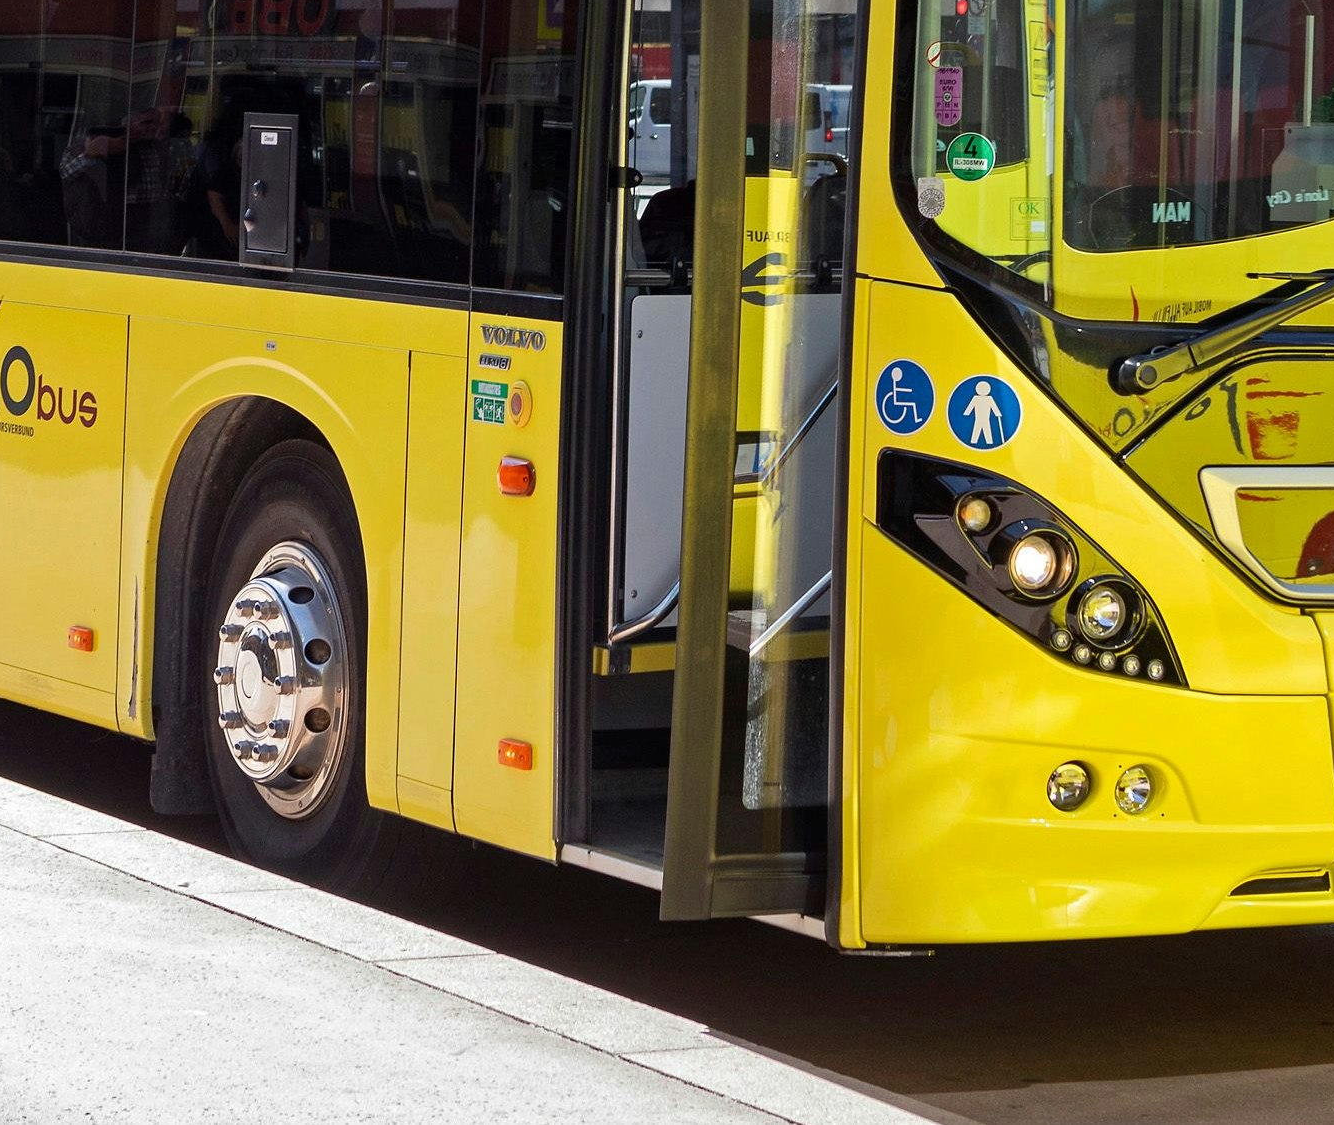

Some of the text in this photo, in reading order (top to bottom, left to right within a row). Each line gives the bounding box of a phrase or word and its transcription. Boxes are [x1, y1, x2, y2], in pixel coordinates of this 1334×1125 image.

[964, 136, 977, 157] 4
[1018, 201, 1041, 215] OK
[480, 323, 547, 352] VOLVO
